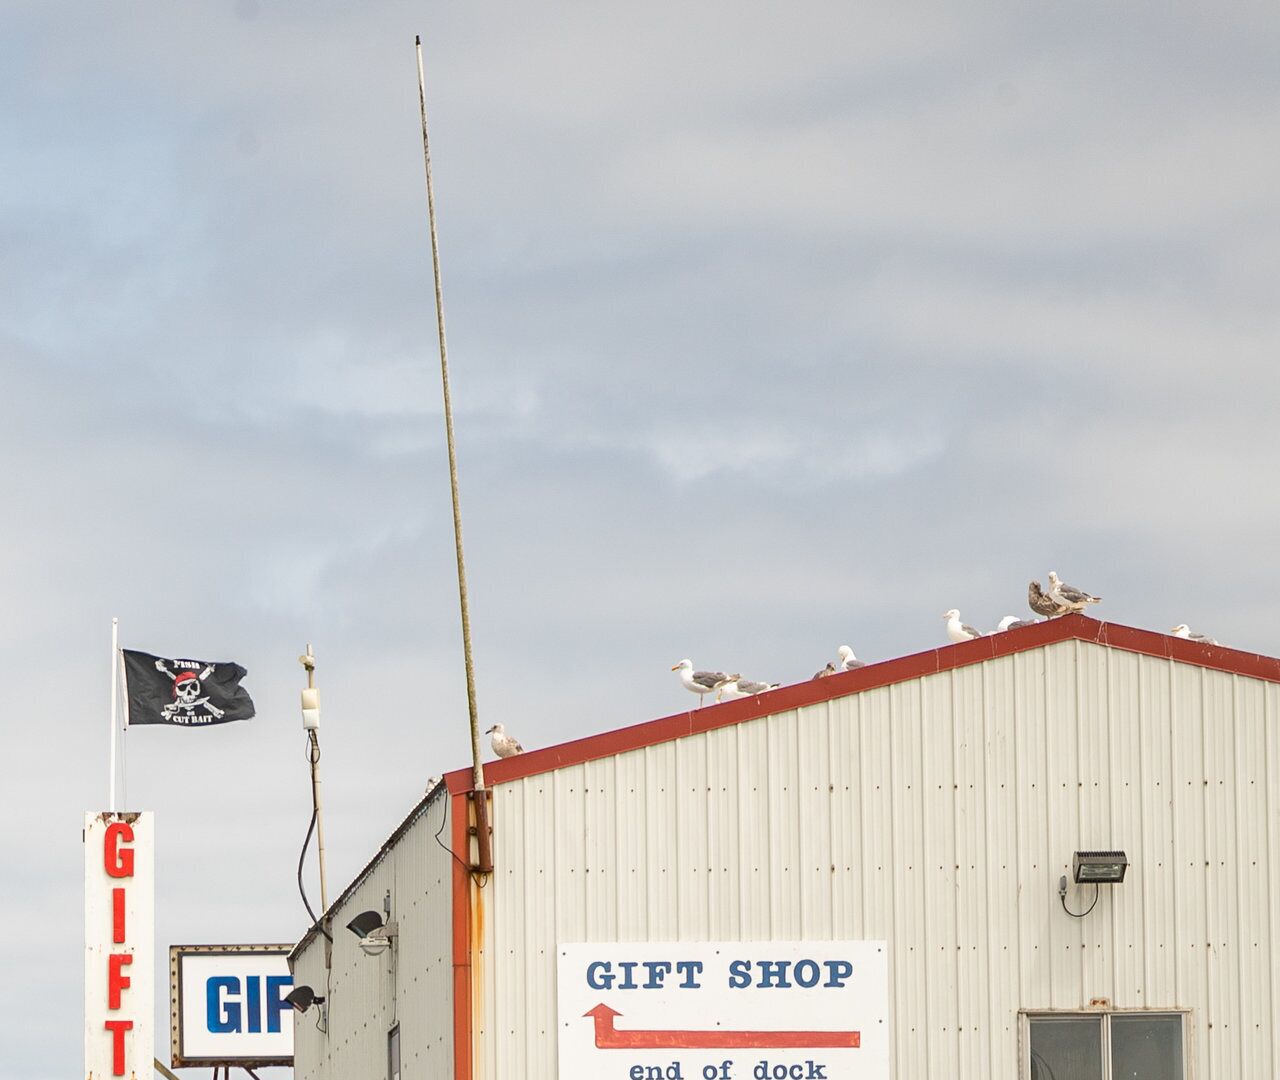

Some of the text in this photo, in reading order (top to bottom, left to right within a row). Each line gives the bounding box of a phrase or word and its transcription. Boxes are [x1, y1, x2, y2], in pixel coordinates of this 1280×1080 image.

[172, 715, 213, 724] CUT BAIT
[104, 822, 135, 1076] GIFT
[586, 959, 853, 990] GIFT SHOP
[629, 1060, 827, 1080] end of dock
